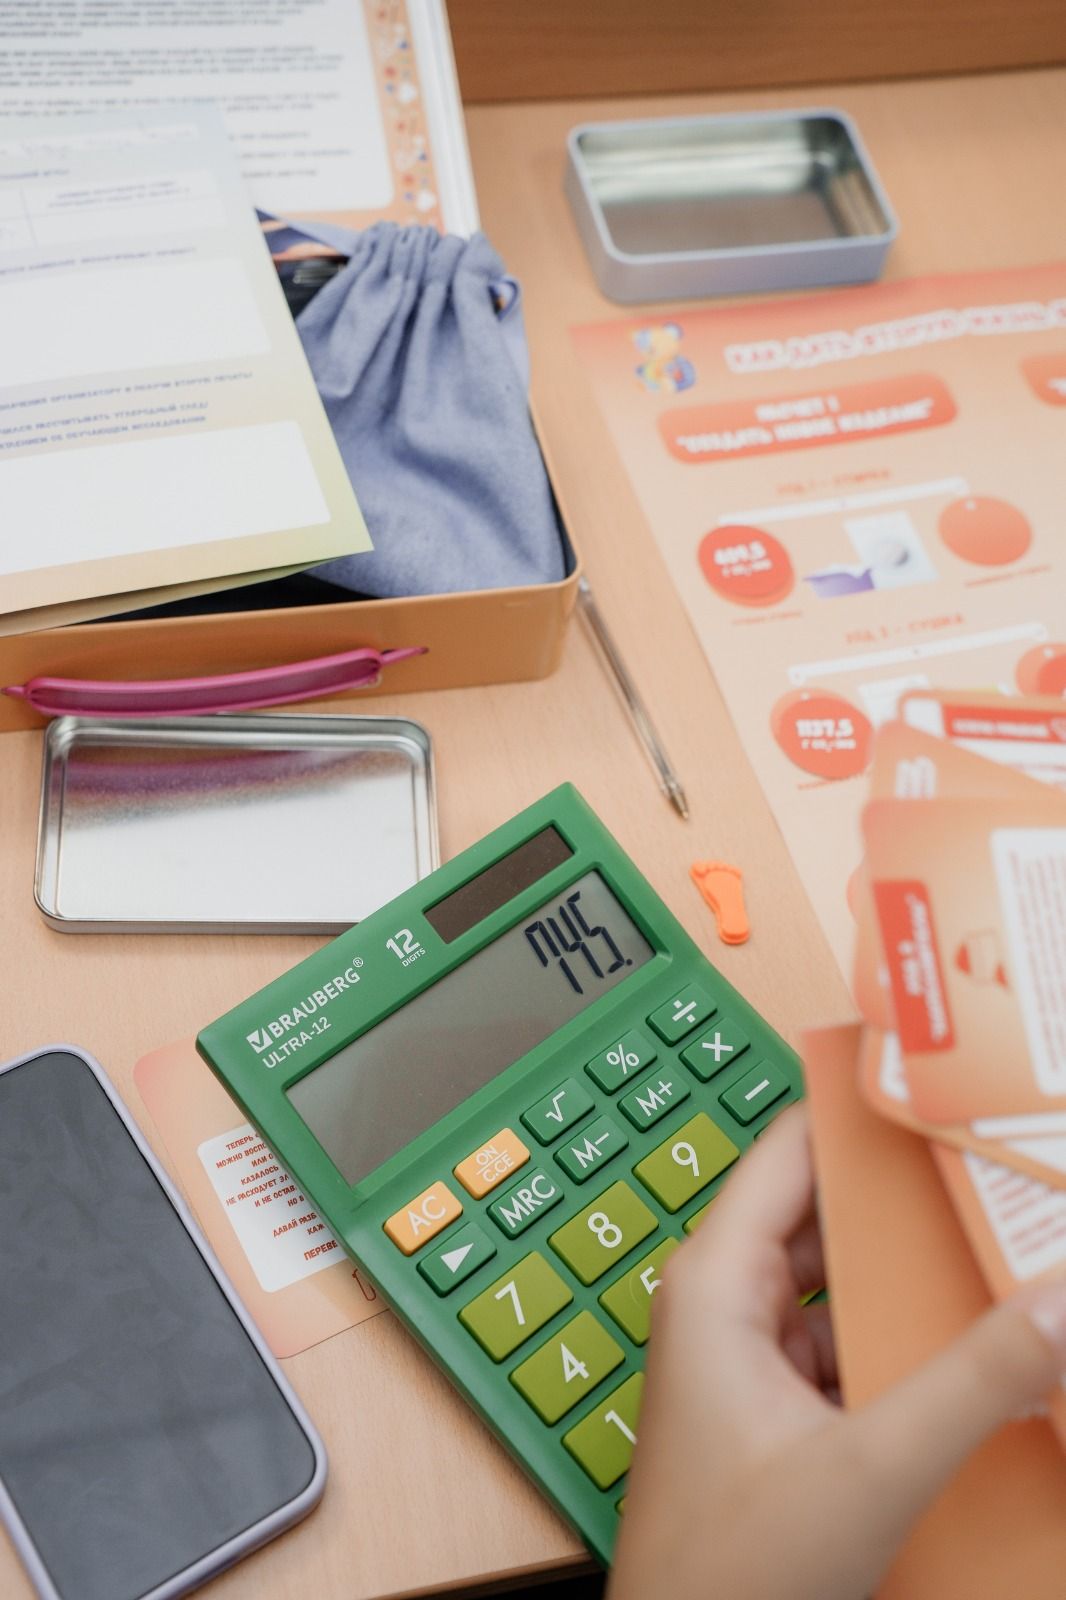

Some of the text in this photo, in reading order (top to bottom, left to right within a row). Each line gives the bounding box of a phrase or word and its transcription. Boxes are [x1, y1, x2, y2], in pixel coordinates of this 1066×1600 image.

[385, 928, 421, 960] 12
[402, 948, 426, 967] DIGITS
[262, 1016, 331, 1069] ULTRA-12
[635, 1079, 673, 1117] M+
[226, 1135, 254, 1151] ТЕПЕРЬ
[476, 1144, 499, 1166] ON
[216, 1152, 243, 1168] МОЖНО
[251, 1157, 267, 1168] ИЛИ
[671, 1141, 700, 1177] 9
[241, 1165, 279, 1185] КАЗАЛОСЬ
[226, 1197, 236, 1206] НЕ
[237, 1178, 277, 1201] РАСХОДУЕТ
[254, 1199, 261, 1207] И
[262, 1194, 272, 1204] НЕ
[287, 1198, 298, 1207] НО
[498, 1173, 556, 1229] MRC
[272, 1219, 298, 1238] ДАВАЙ
[407, 1195, 447, 1236] AC
[586, 1211, 623, 1249] 8
[494, 1281, 526, 1326] 7
[560, 1342, 590, 1384] 4
